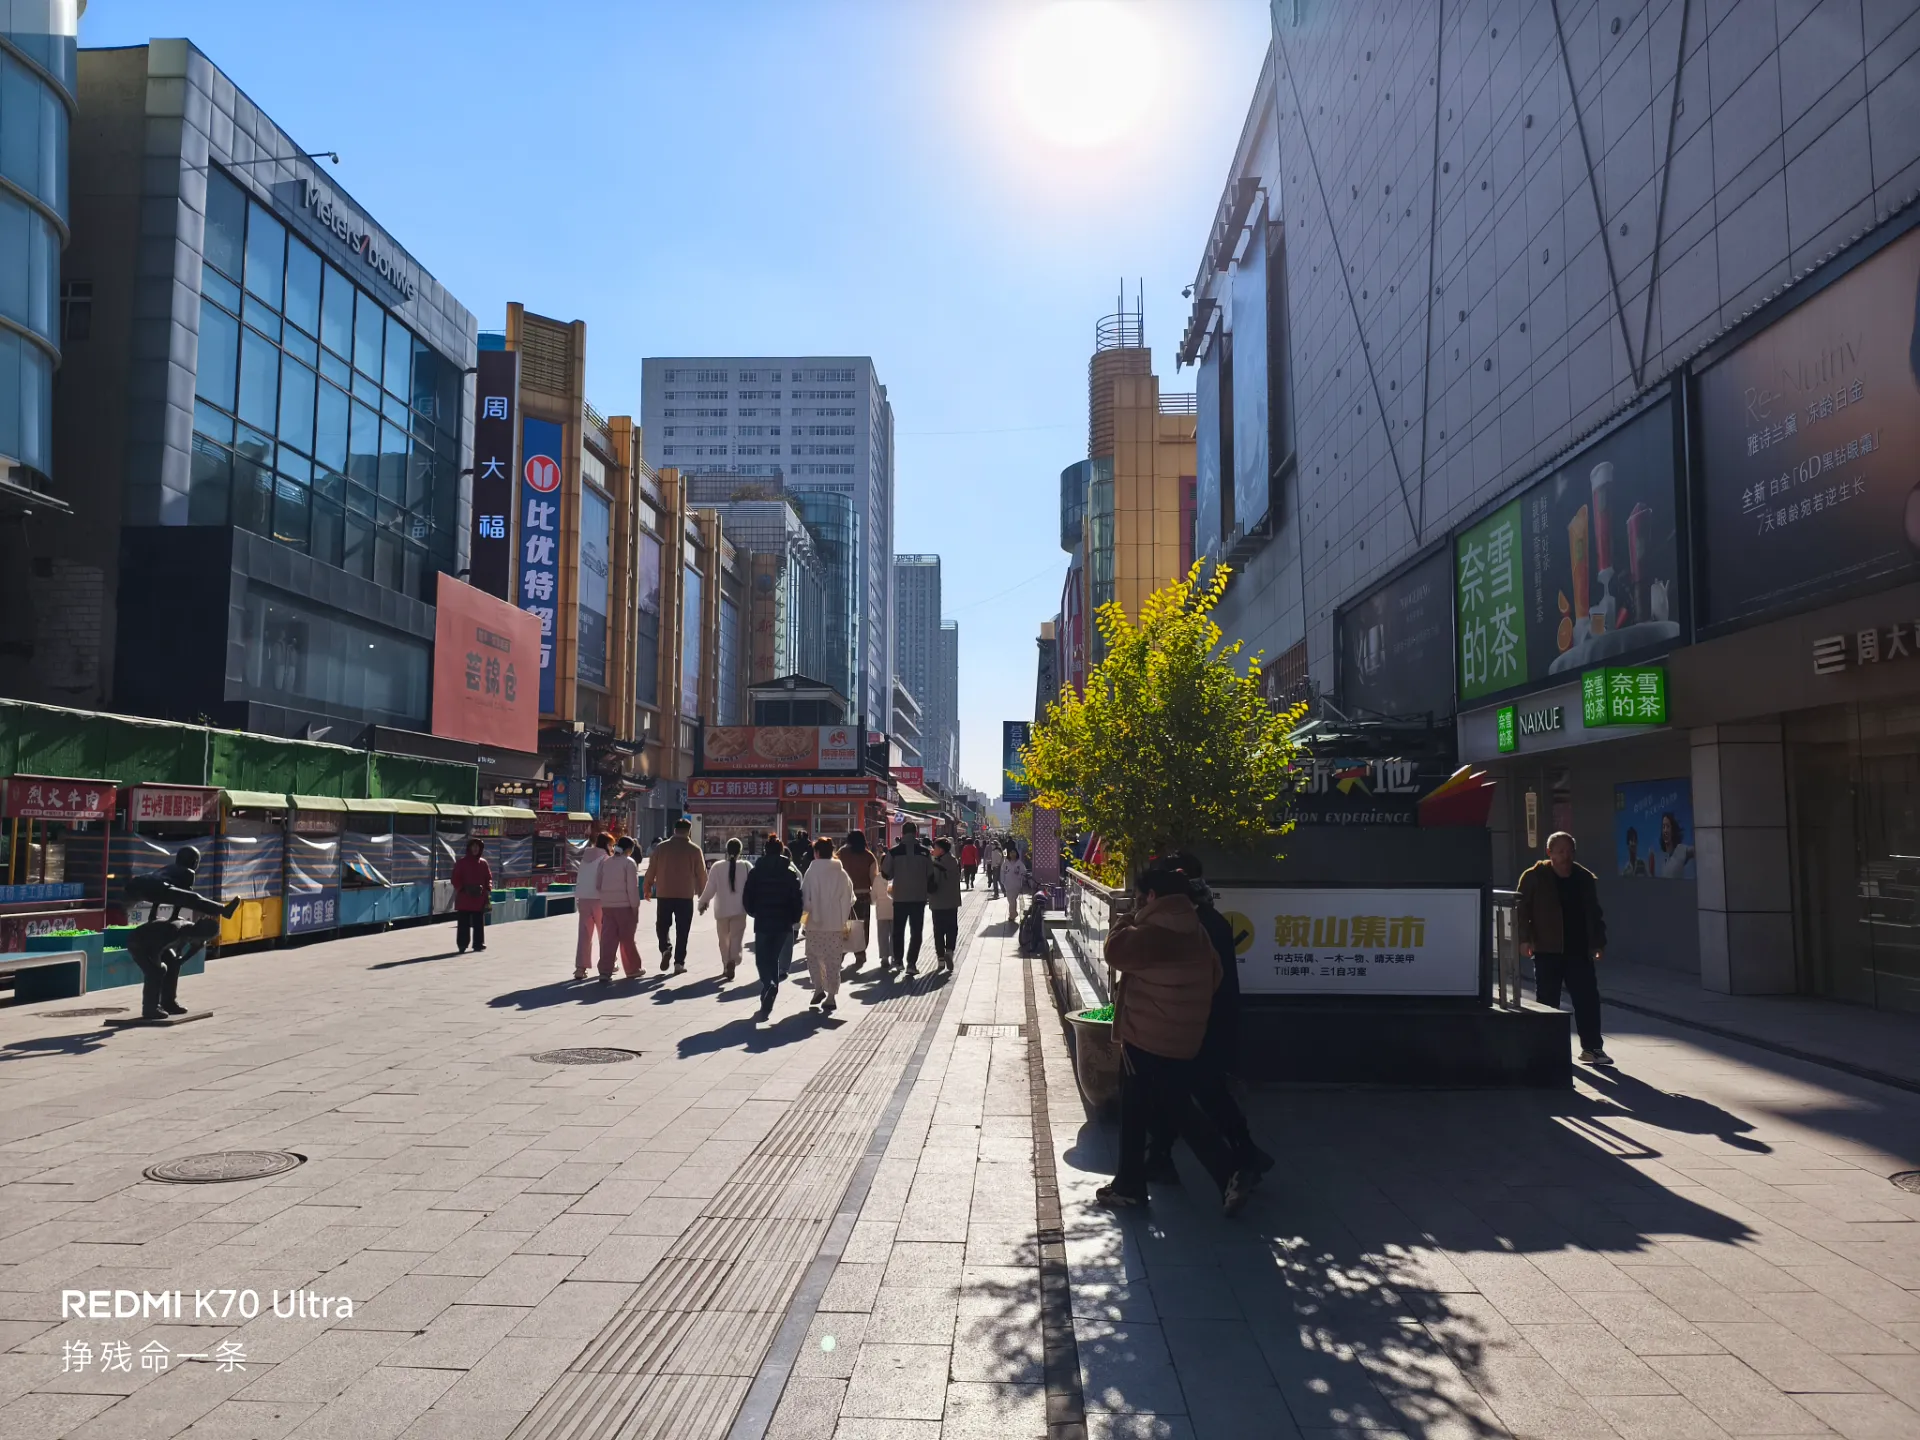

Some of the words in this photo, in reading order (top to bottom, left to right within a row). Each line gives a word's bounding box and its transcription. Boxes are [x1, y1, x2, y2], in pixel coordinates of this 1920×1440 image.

[1744, 331, 1863, 428] Re-Nutriv
[1747, 411, 1799, 457] 雅诗兰黛
[1805, 376, 1865, 427] 冻龄白金
[479, 396, 508, 539] 周大福
[1741, 480, 1767, 509] 全新
[1459, 520, 1515, 613] 奈雪
[1463, 602, 1520, 689] 的茶
[1857, 620, 1920, 666] 周大
[1611, 672, 1659, 695] 奈雪
[1519, 706, 1561, 736] NAIXUE
[1612, 696, 1661, 718] 的茶
[27, 785, 100, 811] 烈火牛肉
[711, 781, 774, 795] 正新鸡排
[289, 900, 335, 926] 牛肉蛋堡
[1274, 915, 1426, 949] 鞍山集市
